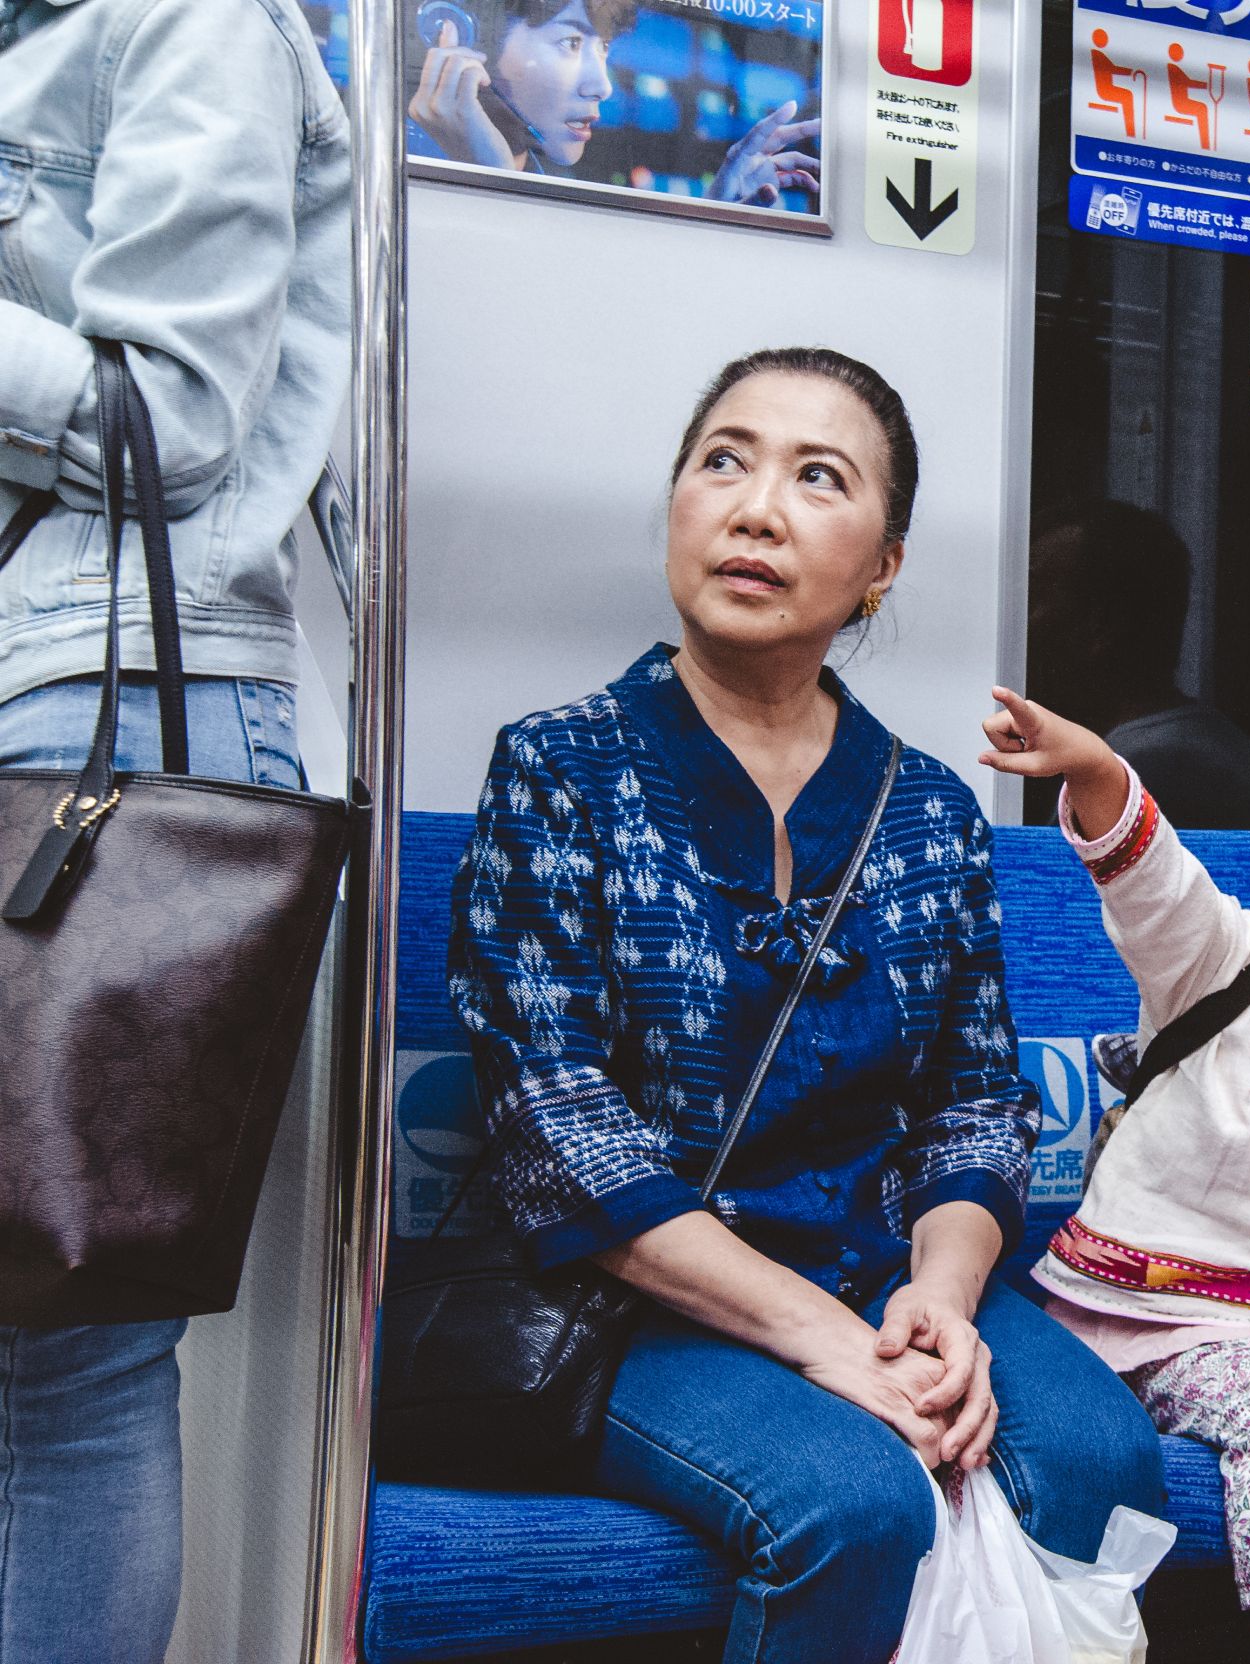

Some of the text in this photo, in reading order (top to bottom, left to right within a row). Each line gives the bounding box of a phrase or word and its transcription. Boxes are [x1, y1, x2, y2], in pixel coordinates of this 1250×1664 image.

[886, 131, 959, 150] Fire extinguisher
[1103, 209, 1125, 221] OFF
[1148, 219, 1174, 232] When
[1176, 224, 1217, 239] crowded,
[1219, 230, 1248, 243] please
